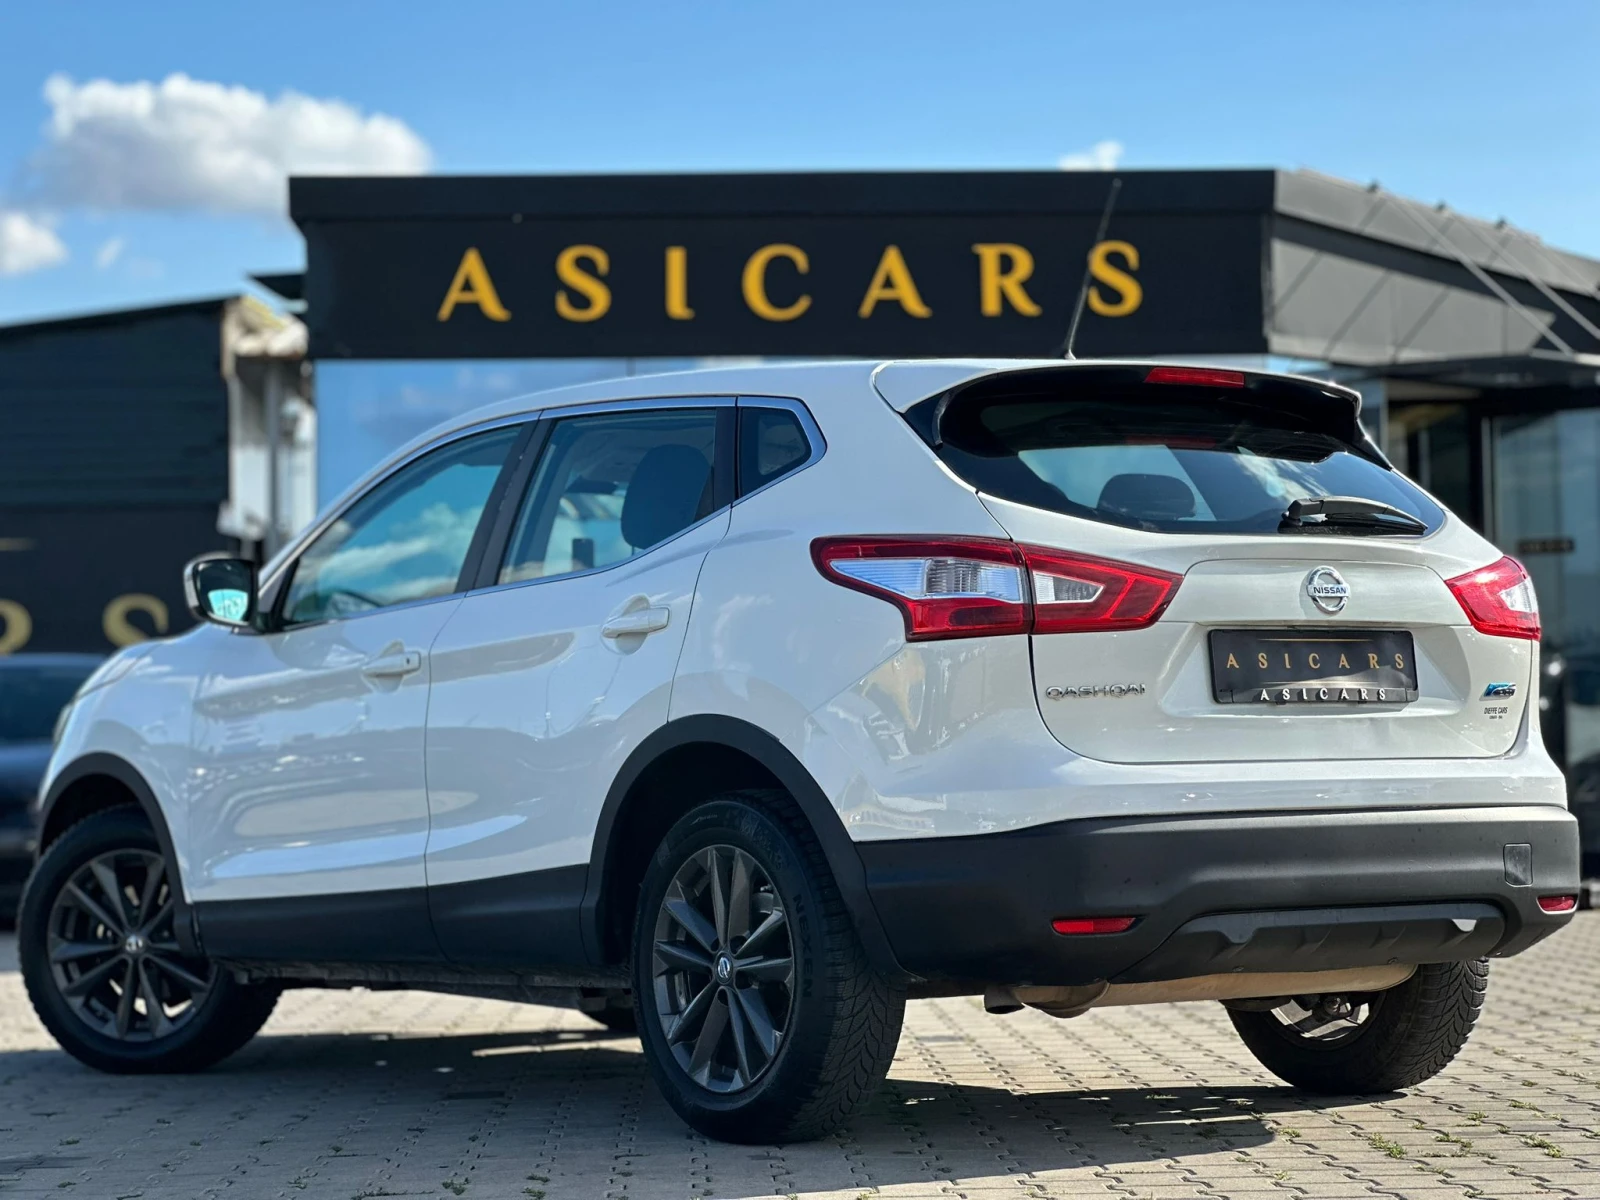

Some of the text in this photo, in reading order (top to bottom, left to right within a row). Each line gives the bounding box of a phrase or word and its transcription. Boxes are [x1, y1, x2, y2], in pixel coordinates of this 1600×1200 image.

[437, 241, 1143, 321] ASICARS
[1313, 586, 1347, 595] NISSAN
[1226, 652, 1405, 670] ASICARS
[1045, 683, 1146, 700] QASHQAI
[1259, 687, 1386, 701] ASICARS
[792, 893, 813, 998] NEXEN
